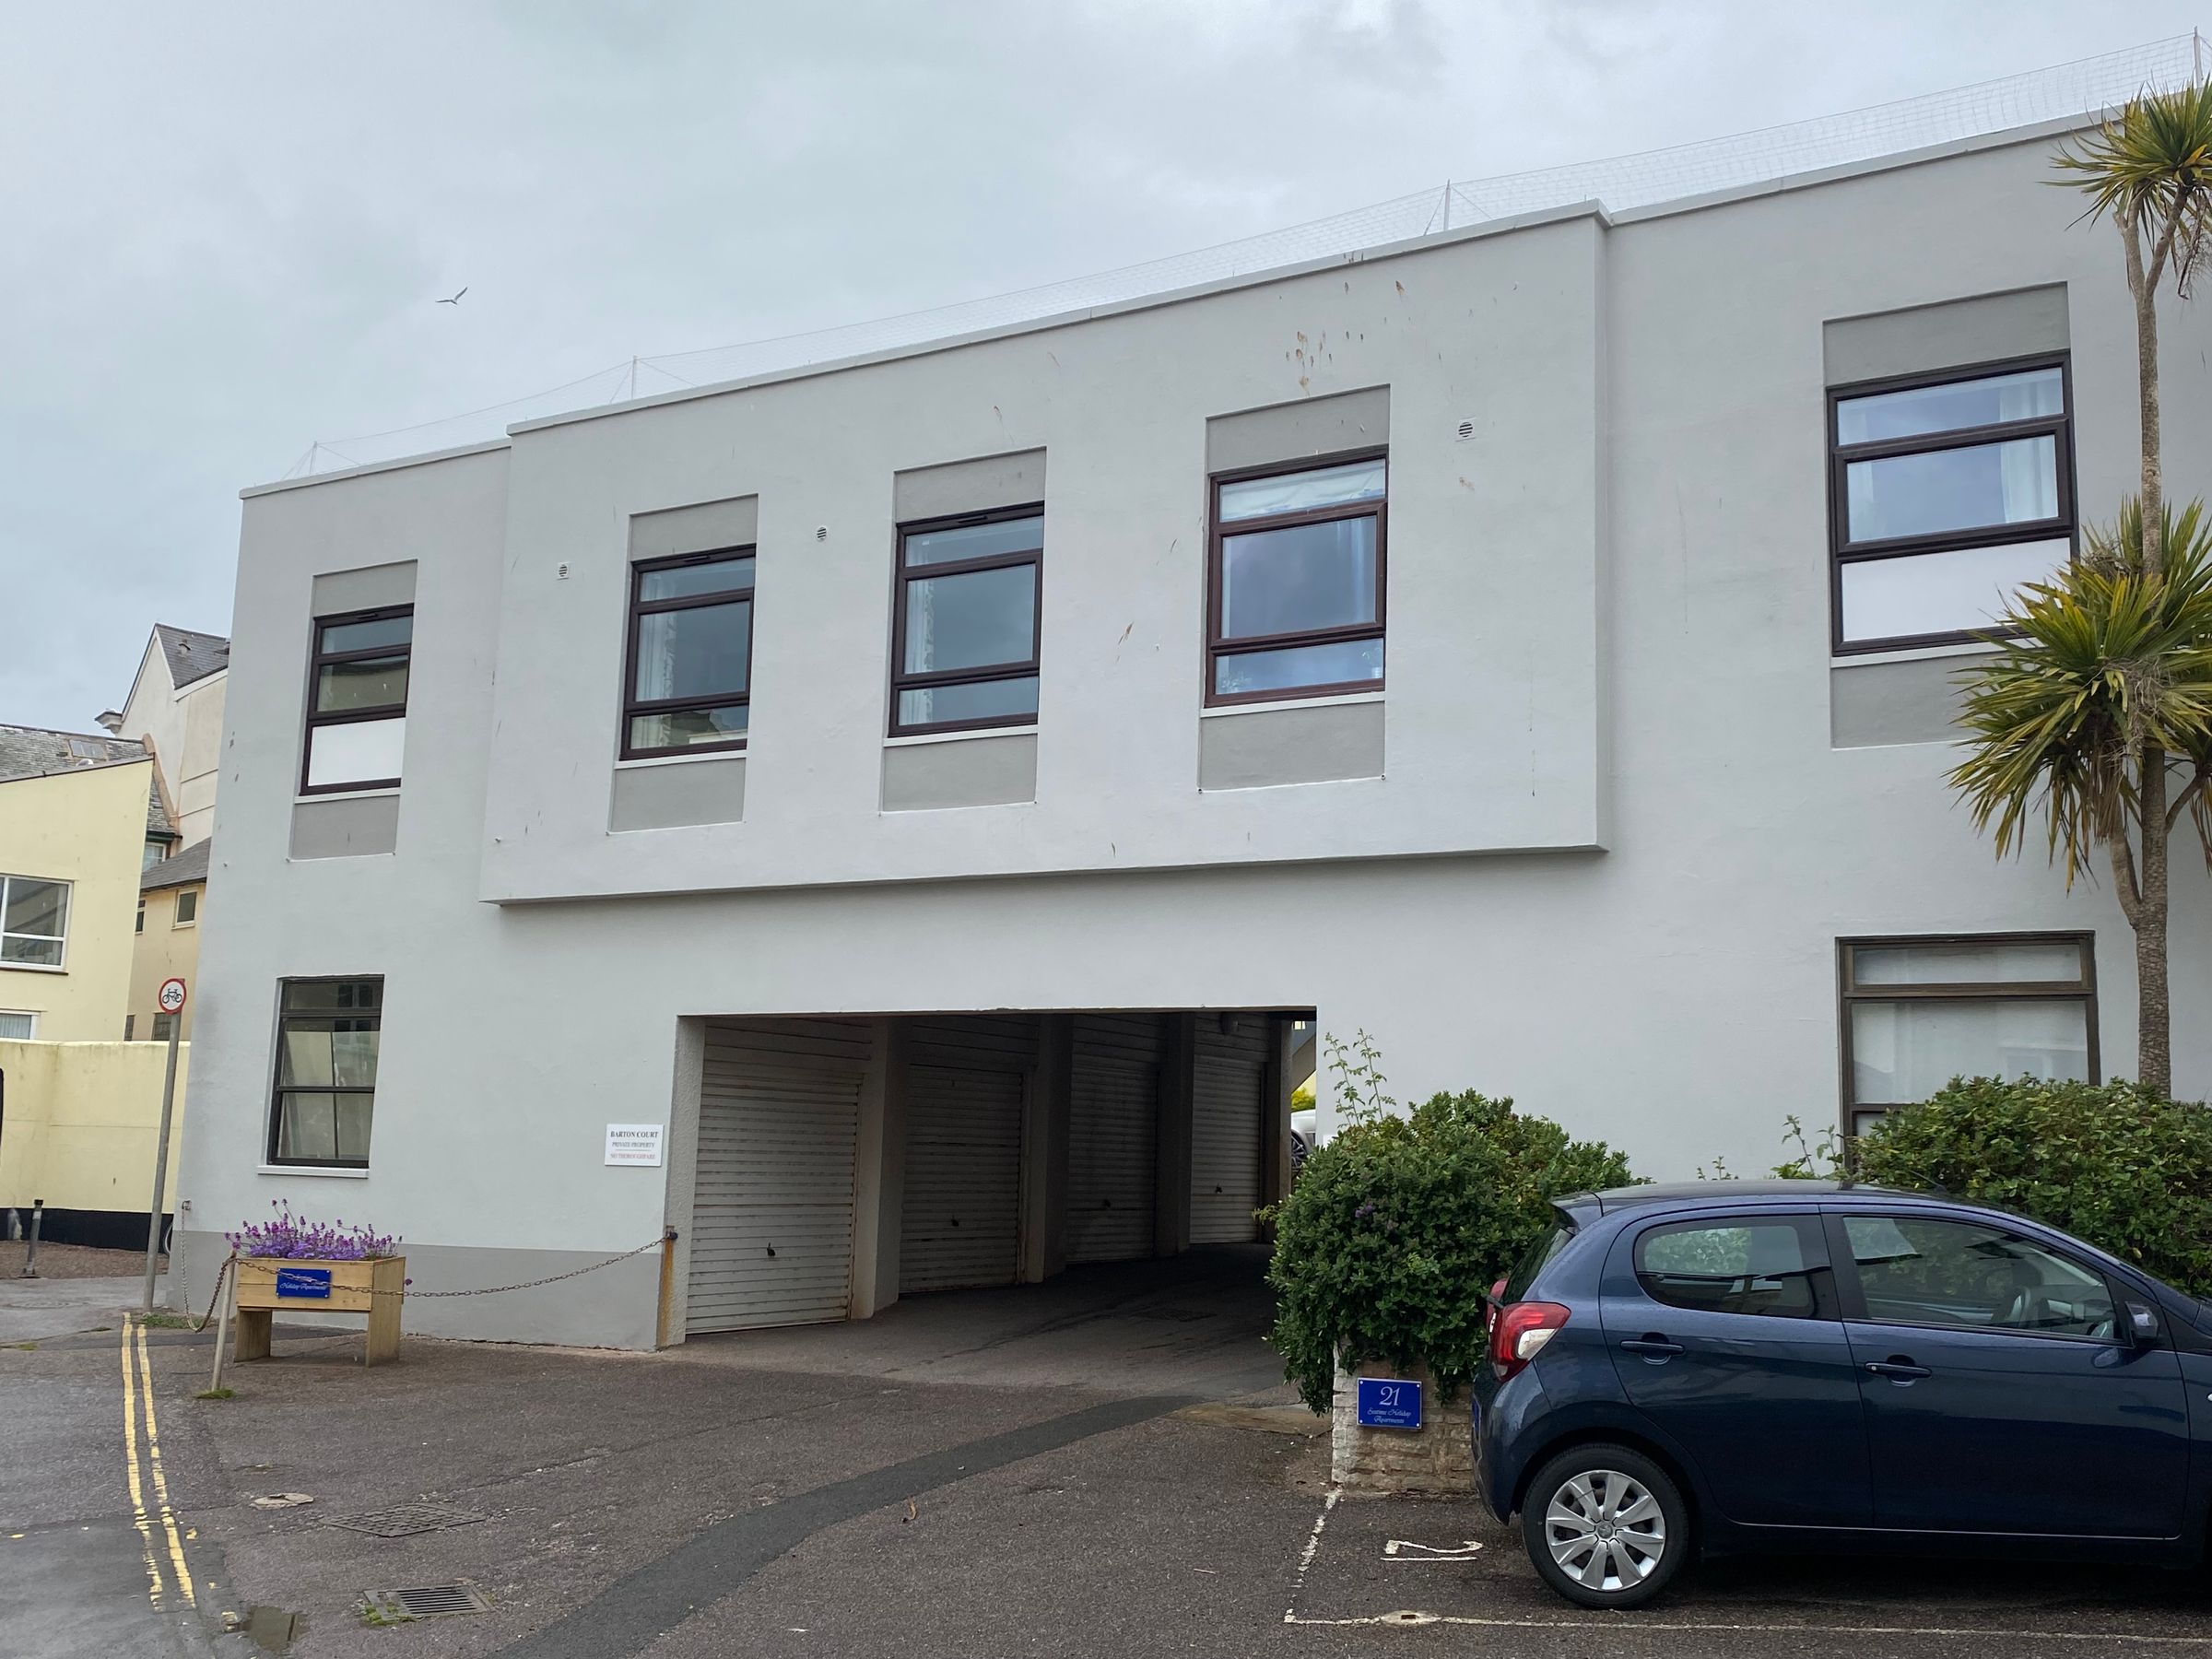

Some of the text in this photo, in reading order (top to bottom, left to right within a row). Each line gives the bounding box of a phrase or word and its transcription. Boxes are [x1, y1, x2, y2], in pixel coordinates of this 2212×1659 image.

[1379, 1385, 1401, 1406] 21
[1388, 1408, 1412, 1418] Holiday
[1373, 1415, 1405, 1424] Apartments
